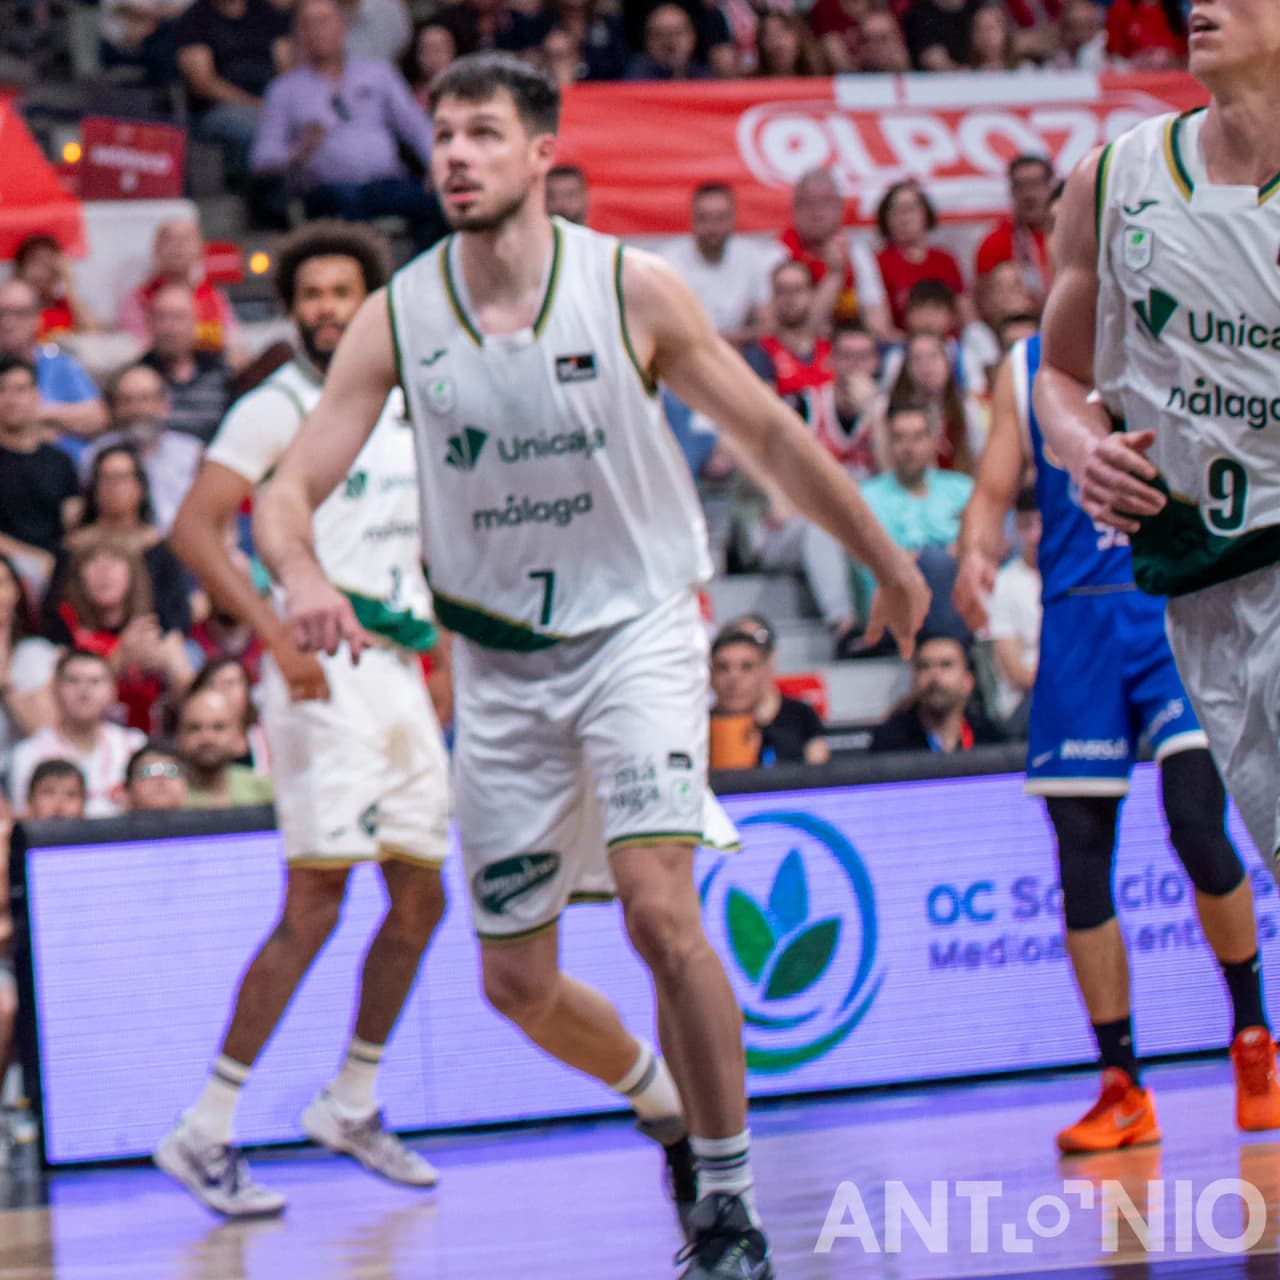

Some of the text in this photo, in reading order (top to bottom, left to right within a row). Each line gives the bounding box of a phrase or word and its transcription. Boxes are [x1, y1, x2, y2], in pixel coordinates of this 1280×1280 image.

[1204, 456, 1248, 534] 9
[528, 568, 556, 627] 7
[926, 880, 995, 927] OC
